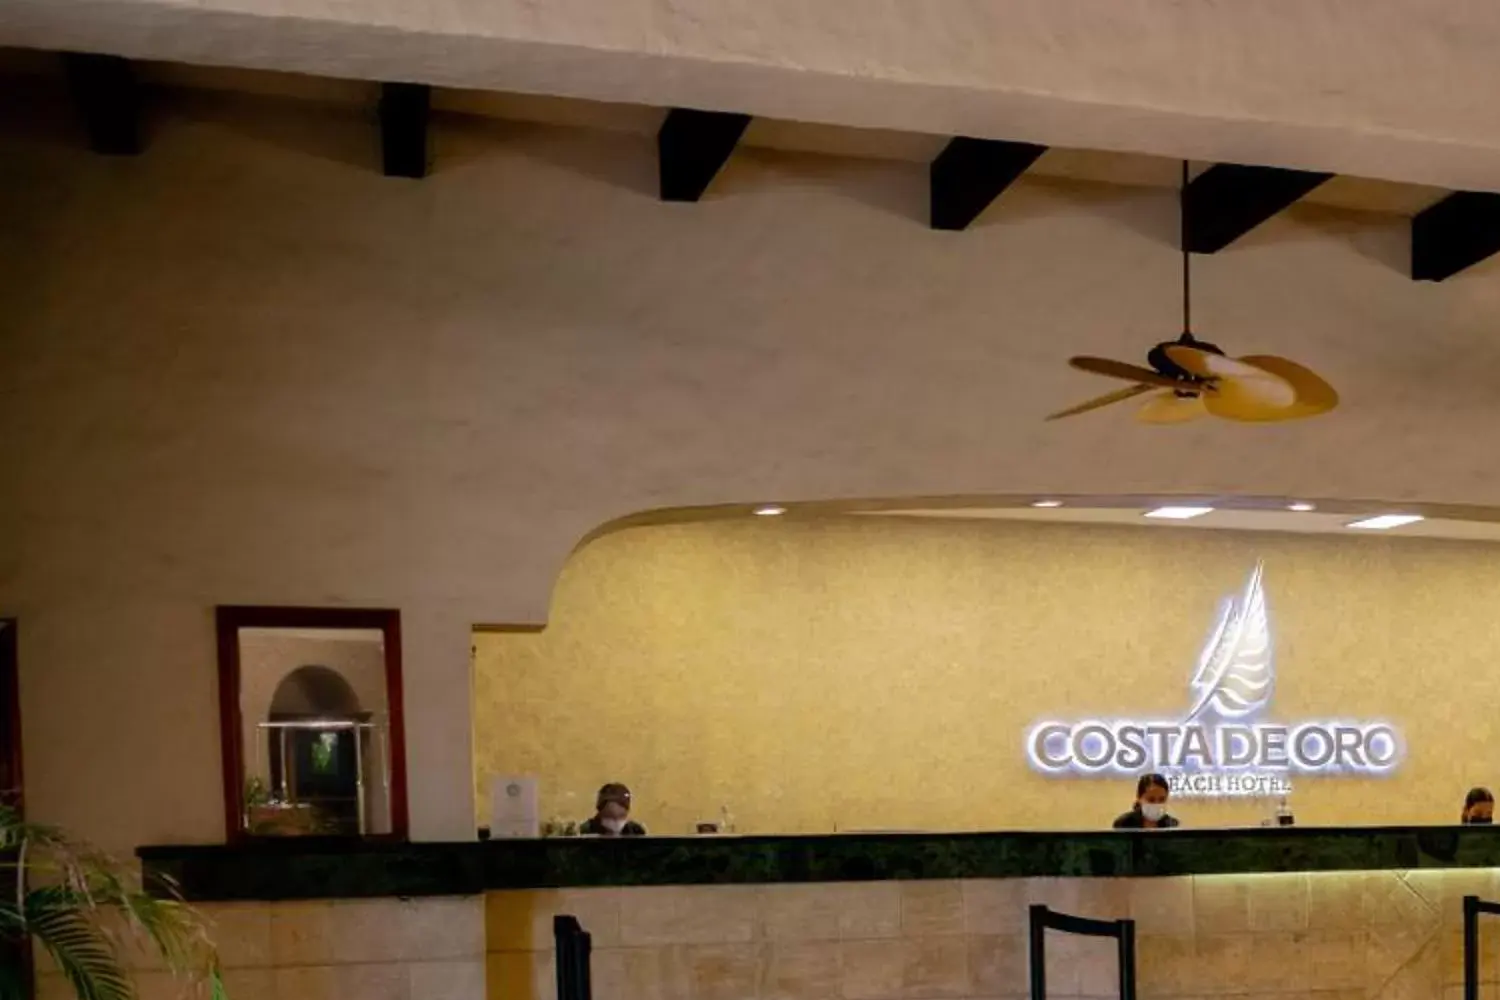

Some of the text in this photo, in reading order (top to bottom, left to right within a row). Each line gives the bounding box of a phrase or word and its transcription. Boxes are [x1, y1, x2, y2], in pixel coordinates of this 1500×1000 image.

[1034, 724, 1398, 767] COSTA DE ORO
[1168, 775, 1291, 792] EACH HOTEL
